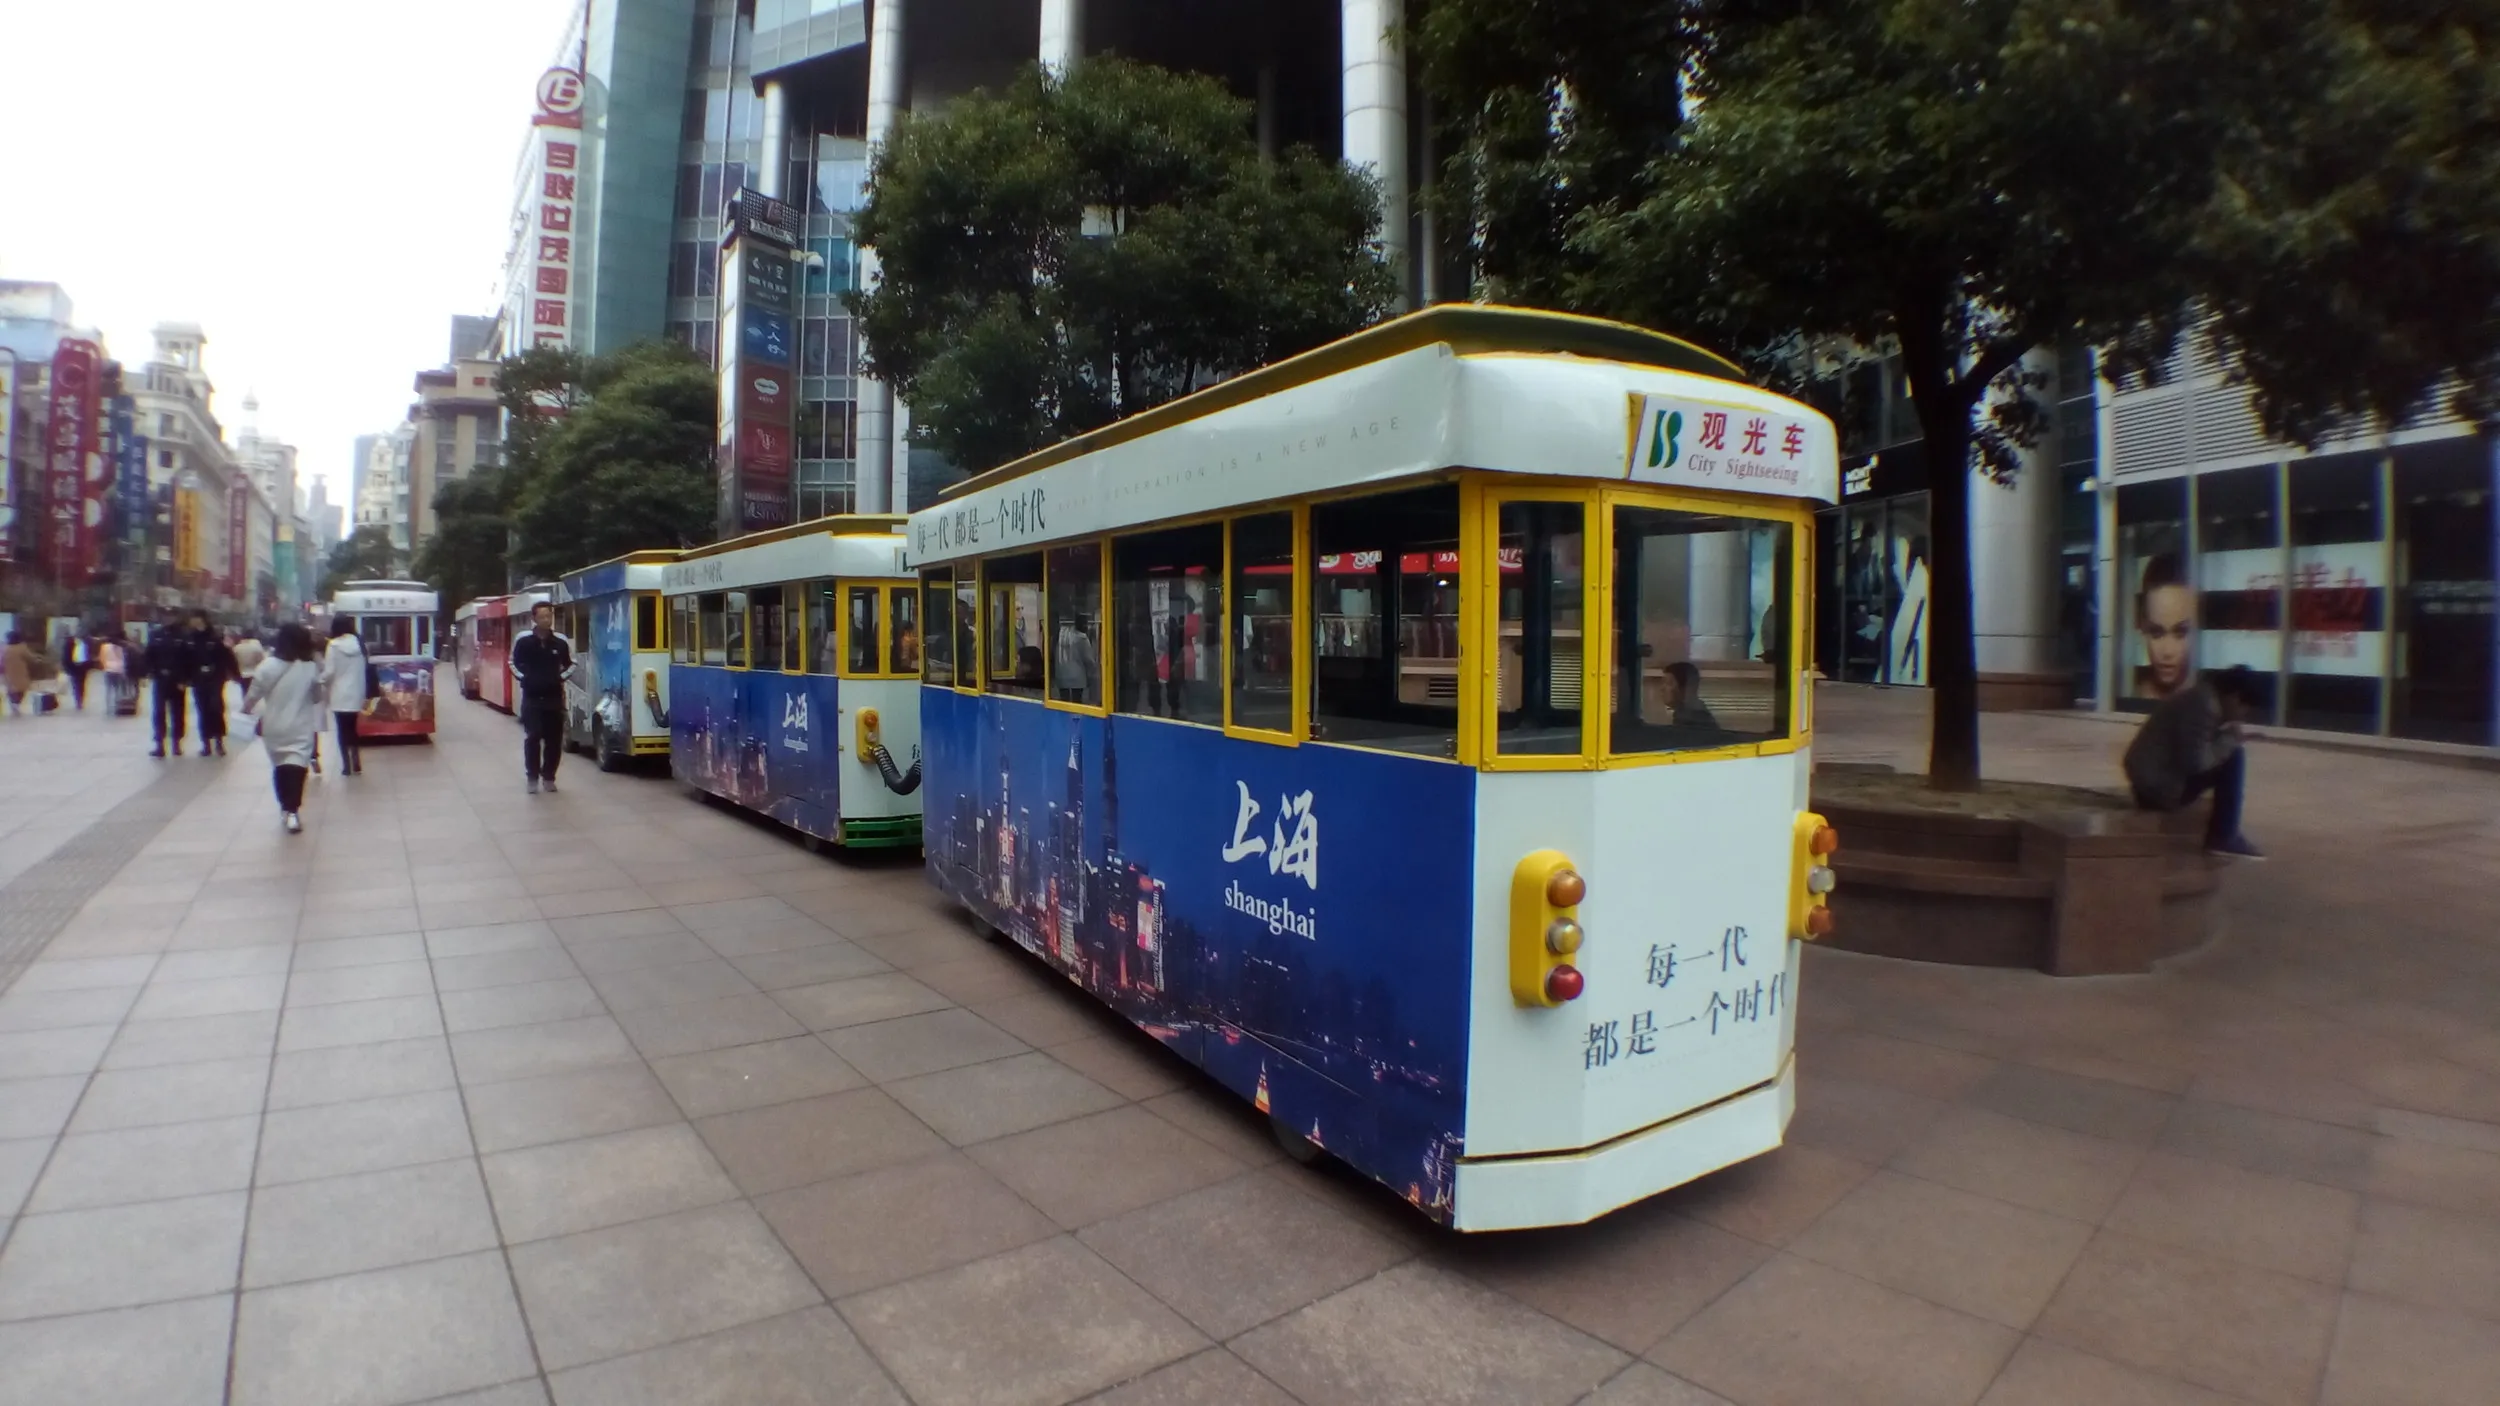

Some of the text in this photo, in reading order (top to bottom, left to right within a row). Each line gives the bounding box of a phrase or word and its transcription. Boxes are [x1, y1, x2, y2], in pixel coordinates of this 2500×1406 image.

[1106, 467, 1205, 502] GENERATION
[1221, 457, 1238, 473] IS
[1256, 452, 1262, 463] A
[1283, 434, 1327, 457] NEW
[1351, 416, 1399, 441] AGE
[1699, 412, 1805, 460] 观光车
[1688, 454, 1799, 485] City Sightseeing
[955, 487, 1046, 546] 都是一个时代
[782, 692, 808, 731] 上海
[1222, 780, 1318, 890] 上海
[1224, 879, 1316, 941] shanghai
[1646, 925, 1748, 988] 每一代
[1582, 972, 1786, 1070] 都是一个时代
